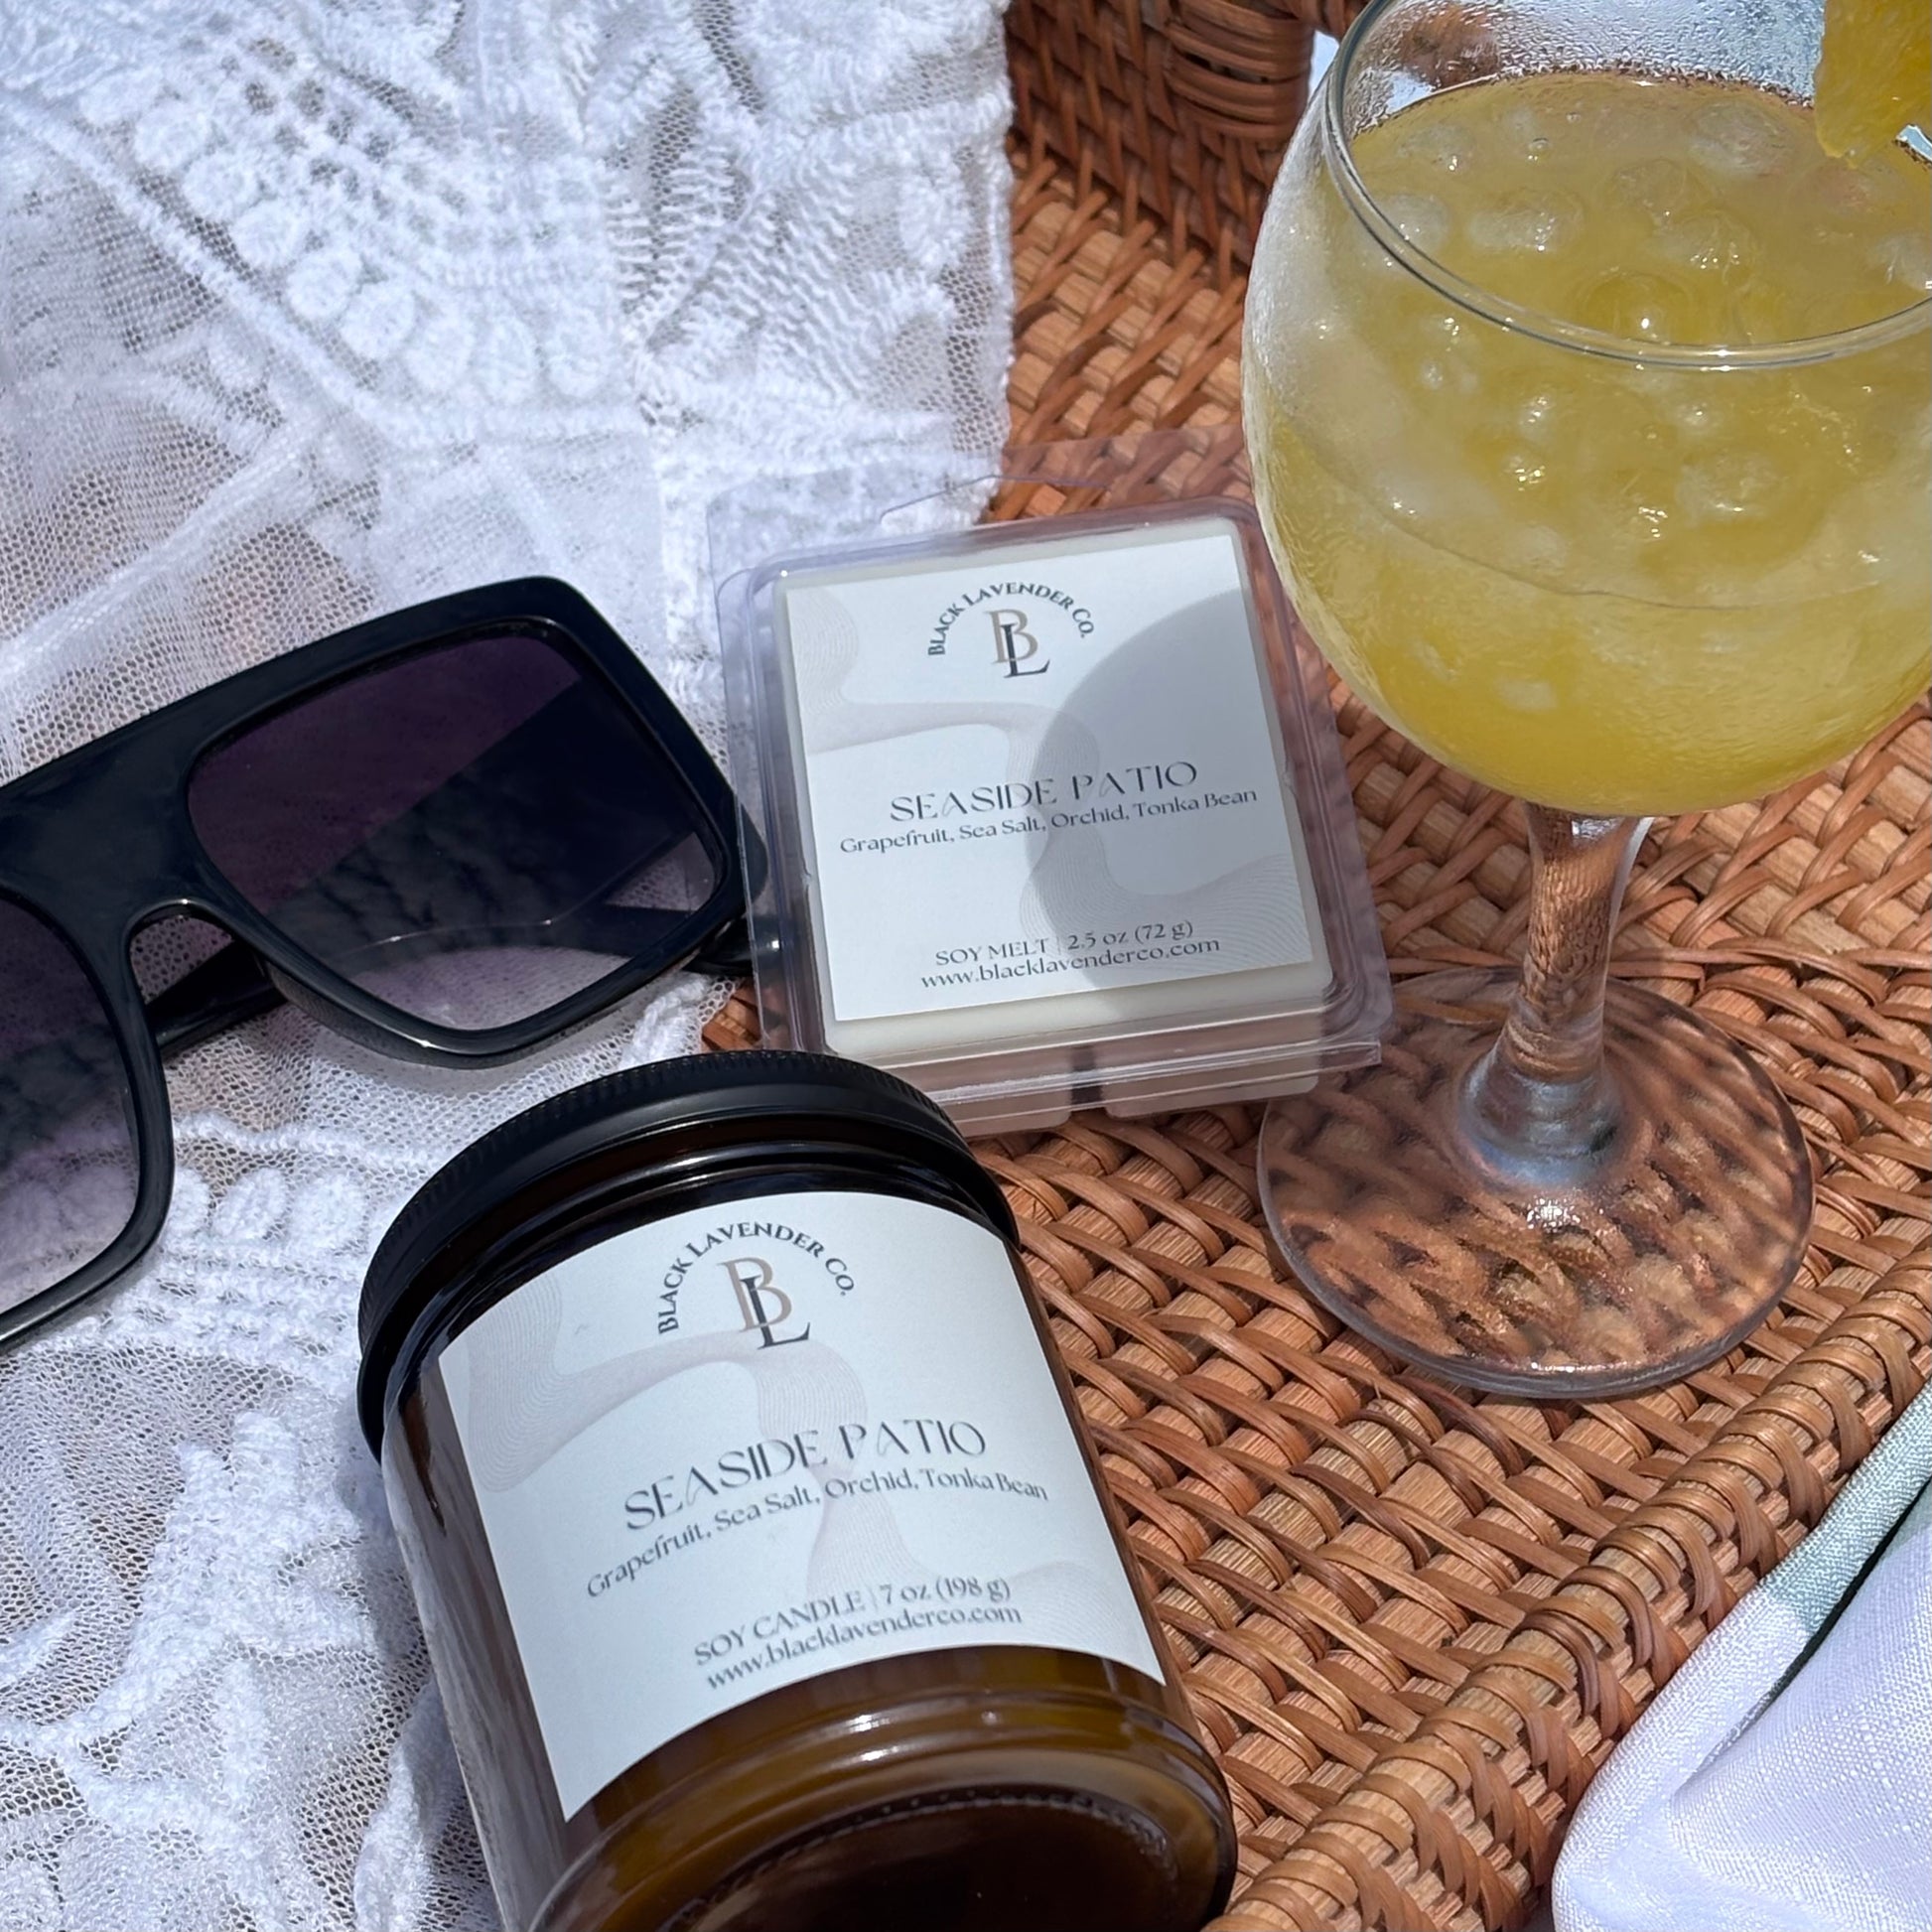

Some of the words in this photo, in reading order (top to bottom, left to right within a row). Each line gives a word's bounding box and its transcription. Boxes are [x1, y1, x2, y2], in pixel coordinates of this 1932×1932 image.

[928, 604, 964, 655] BLACK
[962, 582, 1074, 610] LAVENDER
[840, 828, 955, 854] Grapefruit,
[959, 824, 998, 840] Sea
[1002, 815, 1046, 835] Salt,
[1050, 805, 1130, 830] Orchid,
[1132, 796, 1200, 818] Tonka
[1204, 788, 1257, 809] Bean
[890, 778, 1056, 823] SEASIDE
[1071, 760, 1197, 800] PATIO
[921, 937, 1220, 989] www.blacklavenderco.com
[935, 945, 982, 966] SOY
[988, 938, 1048, 959] MELT
[1067, 932, 1097, 951] 2.5
[1102, 929, 1130, 944] oz
[1135, 923, 1166, 943] (72
[1172, 921, 1193, 939] g)
[658, 1259, 693, 1334] BLACK
[686, 1221, 825, 1259] LAVENDER
[624, 1431, 828, 1531] SEASIDE
[838, 1419, 986, 1459] PATIO
[587, 1526, 712, 1598] Grapefruit,
[715, 1505, 761, 1532] Sea
[764, 1486, 821, 1514] Salt,
[825, 1468, 919, 1499] Orchid,
[922, 1467, 994, 1491] Tonka
[996, 1473, 1048, 1501] Bean
[695, 1625, 747, 1665] SOY
[753, 1592, 865, 1638] CANDLE
[880, 1584, 893, 1604] 7
[899, 1582, 931, 1598] oz
[935, 1577, 984, 1599] (198
[987, 1576, 1010, 1602] g)
[707, 1606, 1021, 1690] www.blacklavenderco.com
